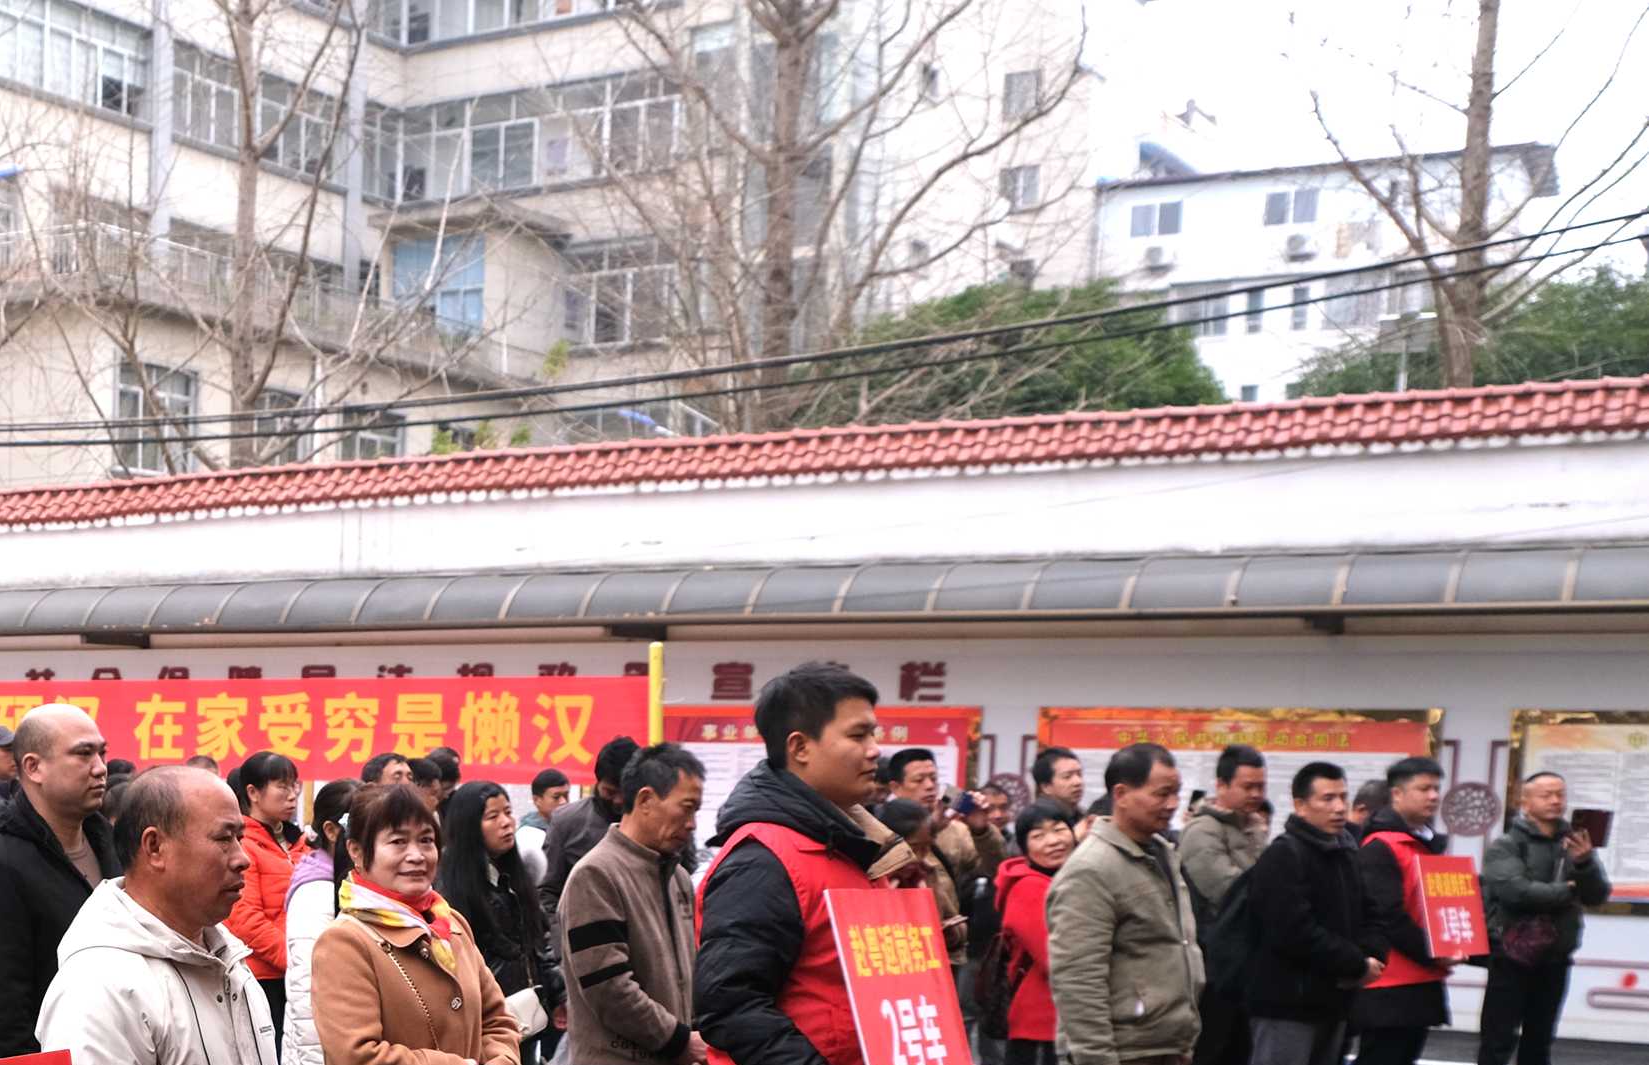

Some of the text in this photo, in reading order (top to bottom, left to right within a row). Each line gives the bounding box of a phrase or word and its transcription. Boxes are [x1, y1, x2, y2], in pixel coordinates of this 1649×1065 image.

[134, 691, 594, 766] 在家受穷是懒汉
[849, 923, 942, 977] 赴粤返岗务工
